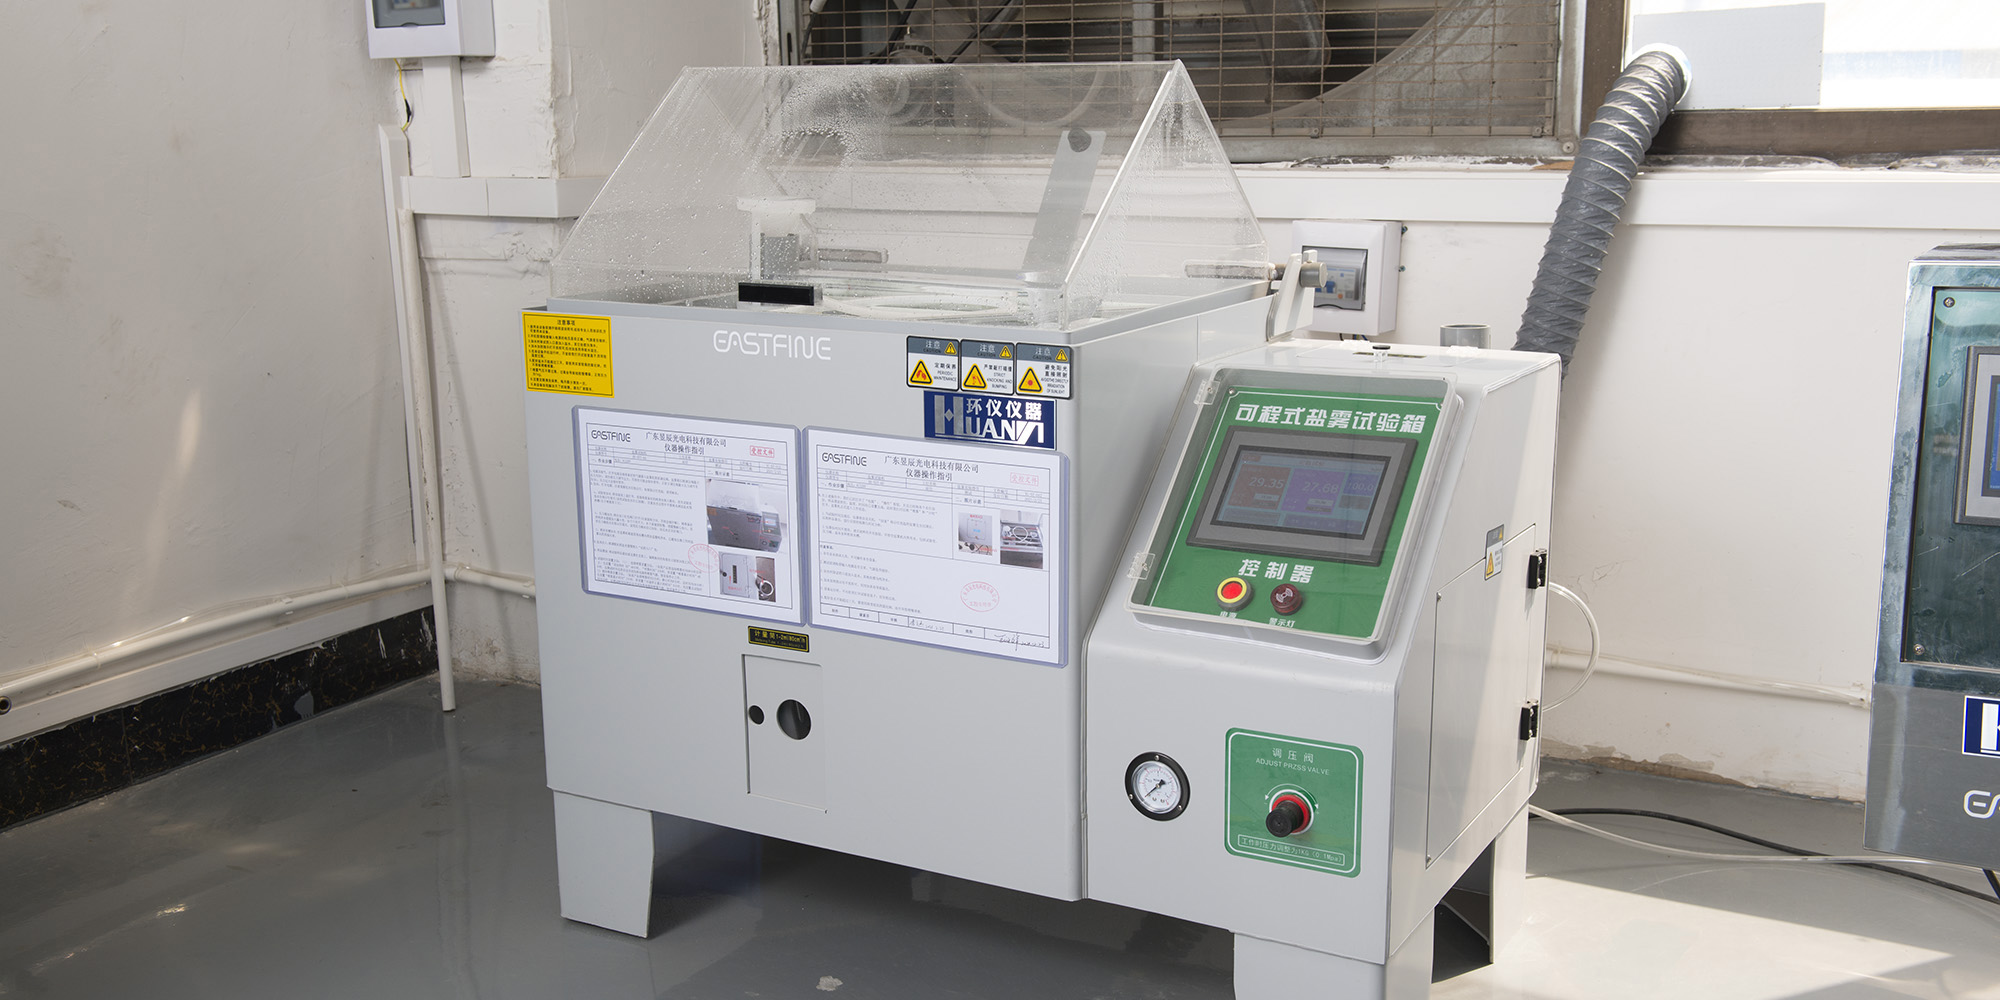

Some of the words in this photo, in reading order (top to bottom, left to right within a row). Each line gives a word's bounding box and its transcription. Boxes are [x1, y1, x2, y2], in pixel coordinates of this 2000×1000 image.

[713, 329, 831, 361] EASTFINE
[925, 340, 940, 349] 注意
[980, 343, 995, 353] 注意
[1035, 347, 1051, 356] 注意
[966, 398, 1042, 421] 环仪仪器
[1235, 403, 1427, 434] 可程式盐雾试验箱
[591, 429, 631, 442] EASTFINE
[664, 443, 705, 455] 仪器操作指引
[751, 447, 773, 456] 受控文件
[821, 452, 867, 467] EASTFINE
[884, 455, 979, 473] 广东昱辰光电科技有限公司
[906, 469, 953, 482] 仪器操作指引
[1249, 476, 1285, 489] 29.35
[1302, 481, 1339, 494] 27.68
[1238, 559, 1314, 584] 控制器
[1269, 617, 1295, 628] 警示灯
[1272, 747, 1314, 764] 调压阀
[1255, 758, 1282, 768] ADJUST
[1283, 762, 1306, 772] PRZSS
[1307, 766, 1330, 776] VALVE
